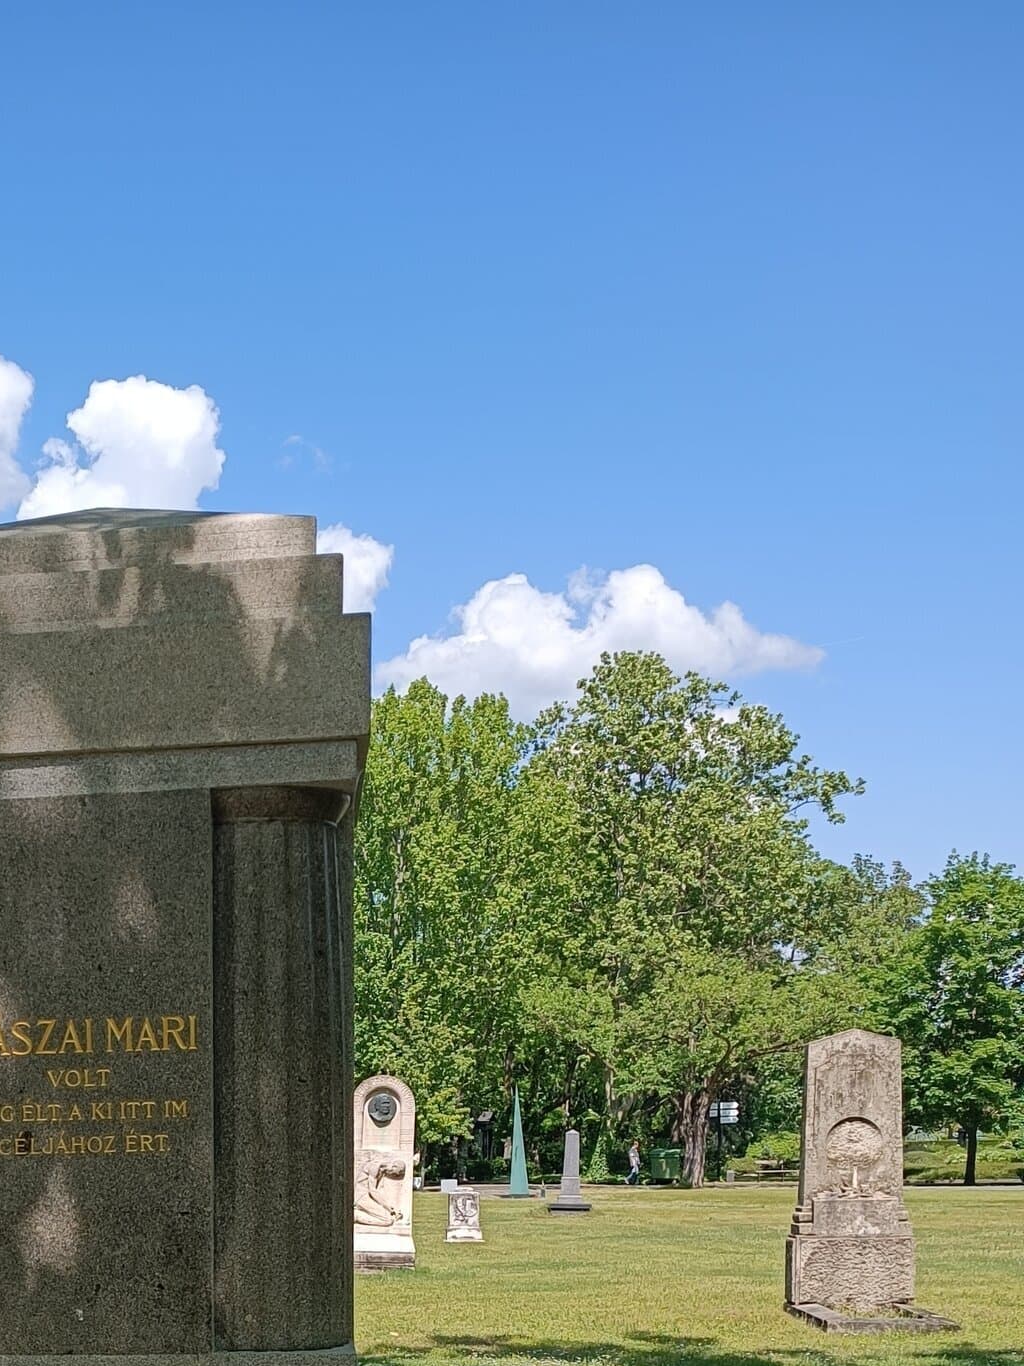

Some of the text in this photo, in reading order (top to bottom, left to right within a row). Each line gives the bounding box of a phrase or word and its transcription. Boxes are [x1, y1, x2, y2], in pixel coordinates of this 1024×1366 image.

[105, 1014, 198, 1052] MARI
[46, 1068, 111, 1088] VOLT
[69, 1104, 82, 1121] A
[91, 1102, 113, 1120] KI
[120, 1101, 156, 1119] ITT
[164, 1100, 189, 1118] IM
